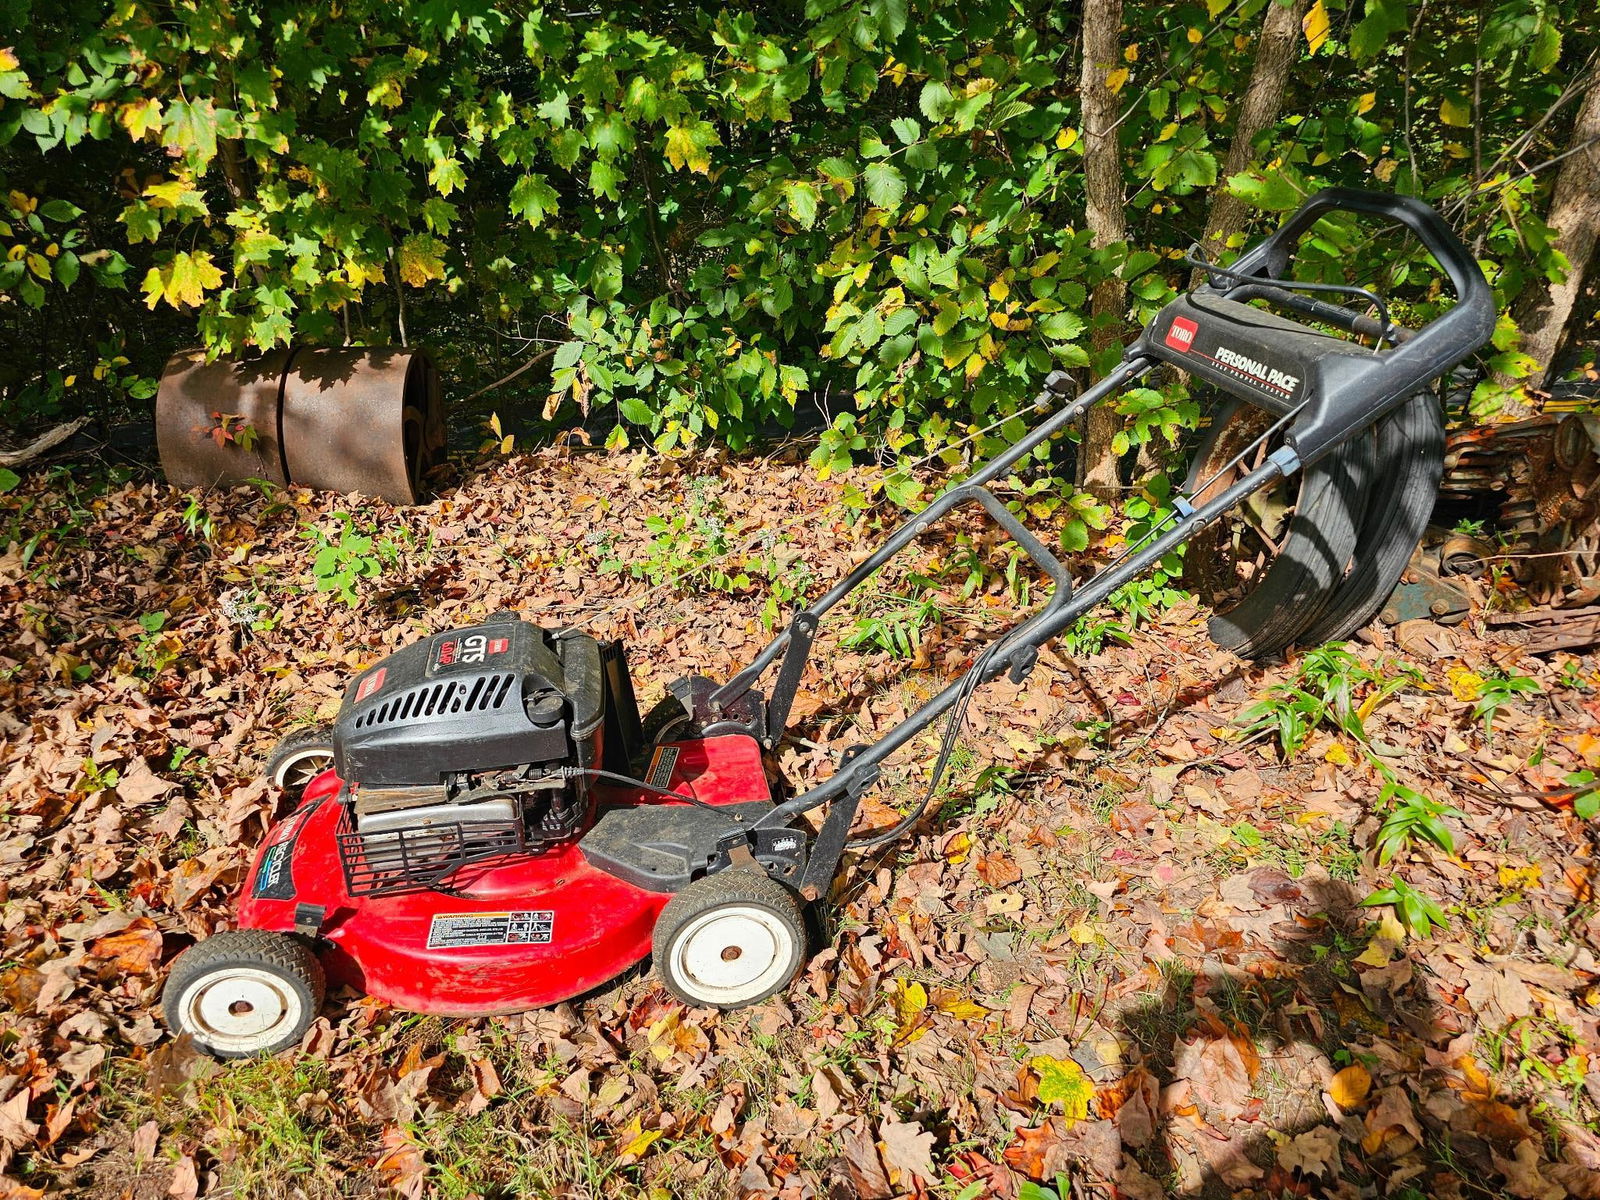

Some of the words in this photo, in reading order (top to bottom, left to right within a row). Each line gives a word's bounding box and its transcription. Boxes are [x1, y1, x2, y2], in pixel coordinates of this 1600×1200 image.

[1172, 325, 1193, 343] TORO
[1214, 346, 1268, 380] PERSONAL
[1266, 368, 1300, 392] PACE
[462, 634, 487, 663] GTS
